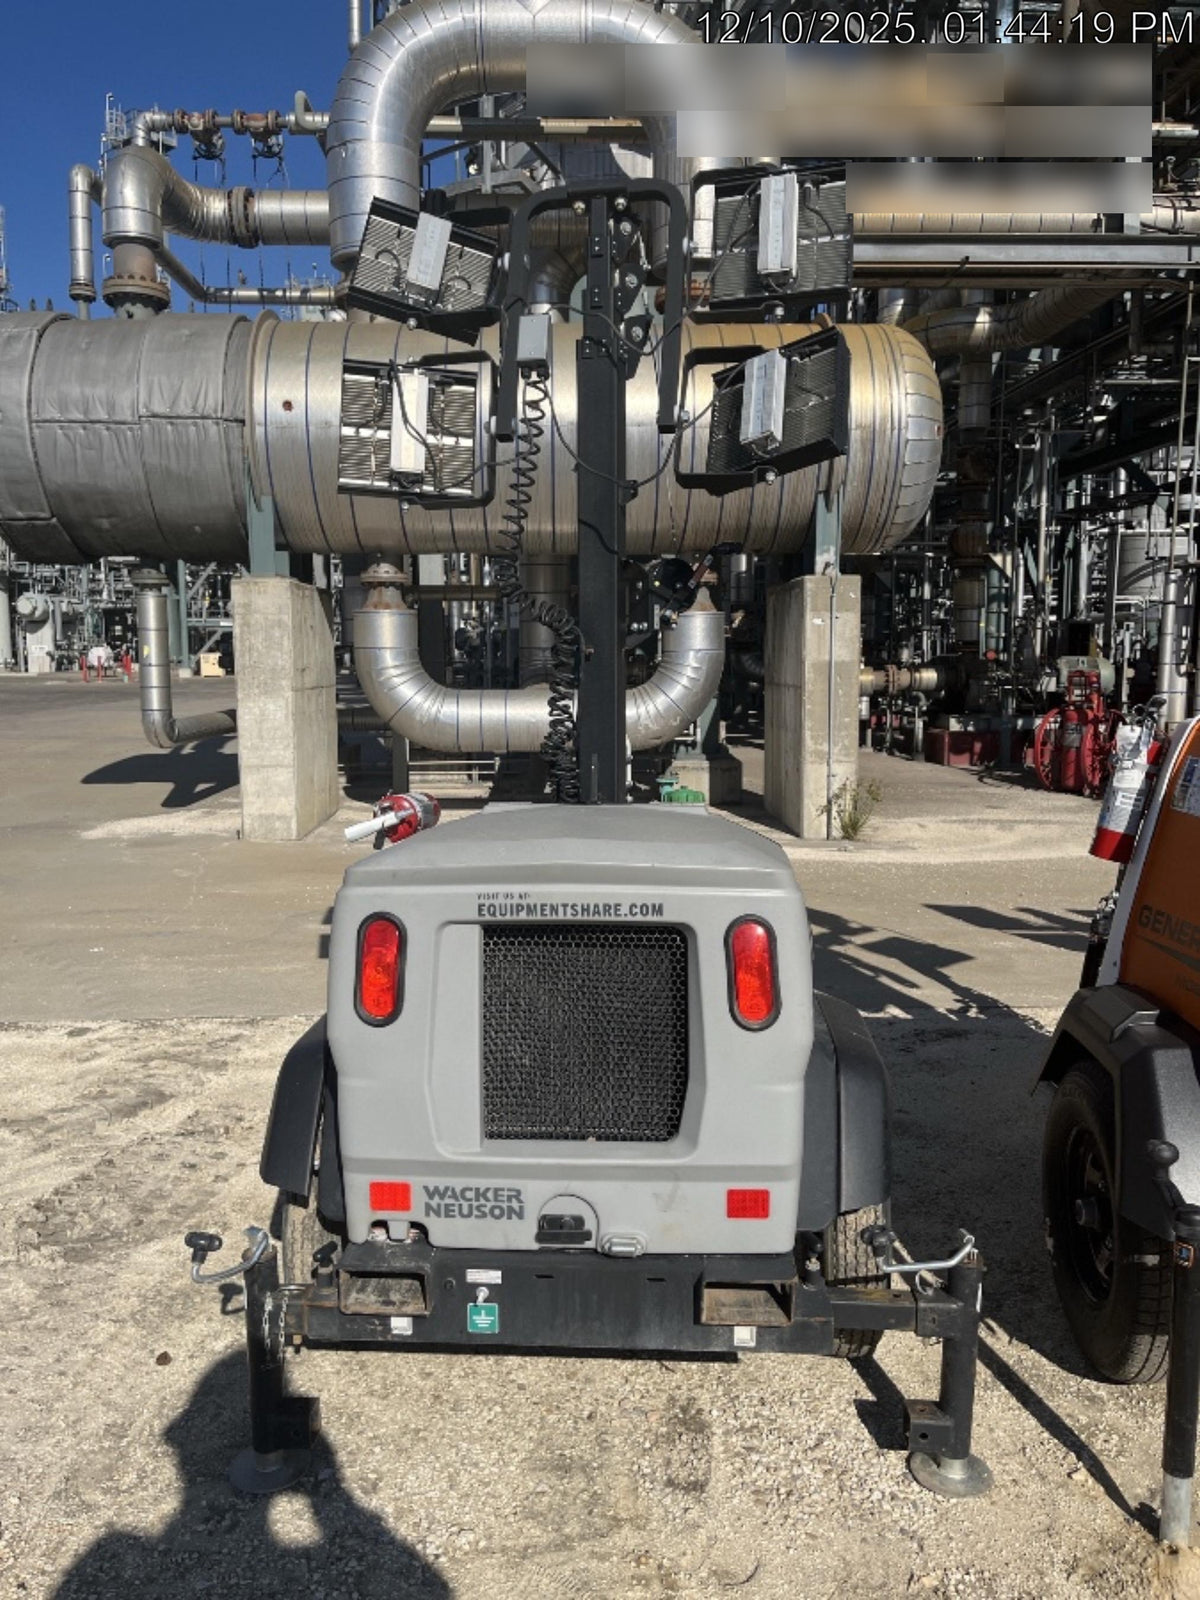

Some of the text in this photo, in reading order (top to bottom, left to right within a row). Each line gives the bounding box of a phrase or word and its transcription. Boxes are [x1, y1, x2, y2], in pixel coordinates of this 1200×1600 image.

[502, 892, 515, 901] US
[477, 902, 664, 918] EQUIPMENTSHARE.COM
[422, 1185, 525, 1204] WACKER
[424, 1201, 525, 1220] NEUSON
